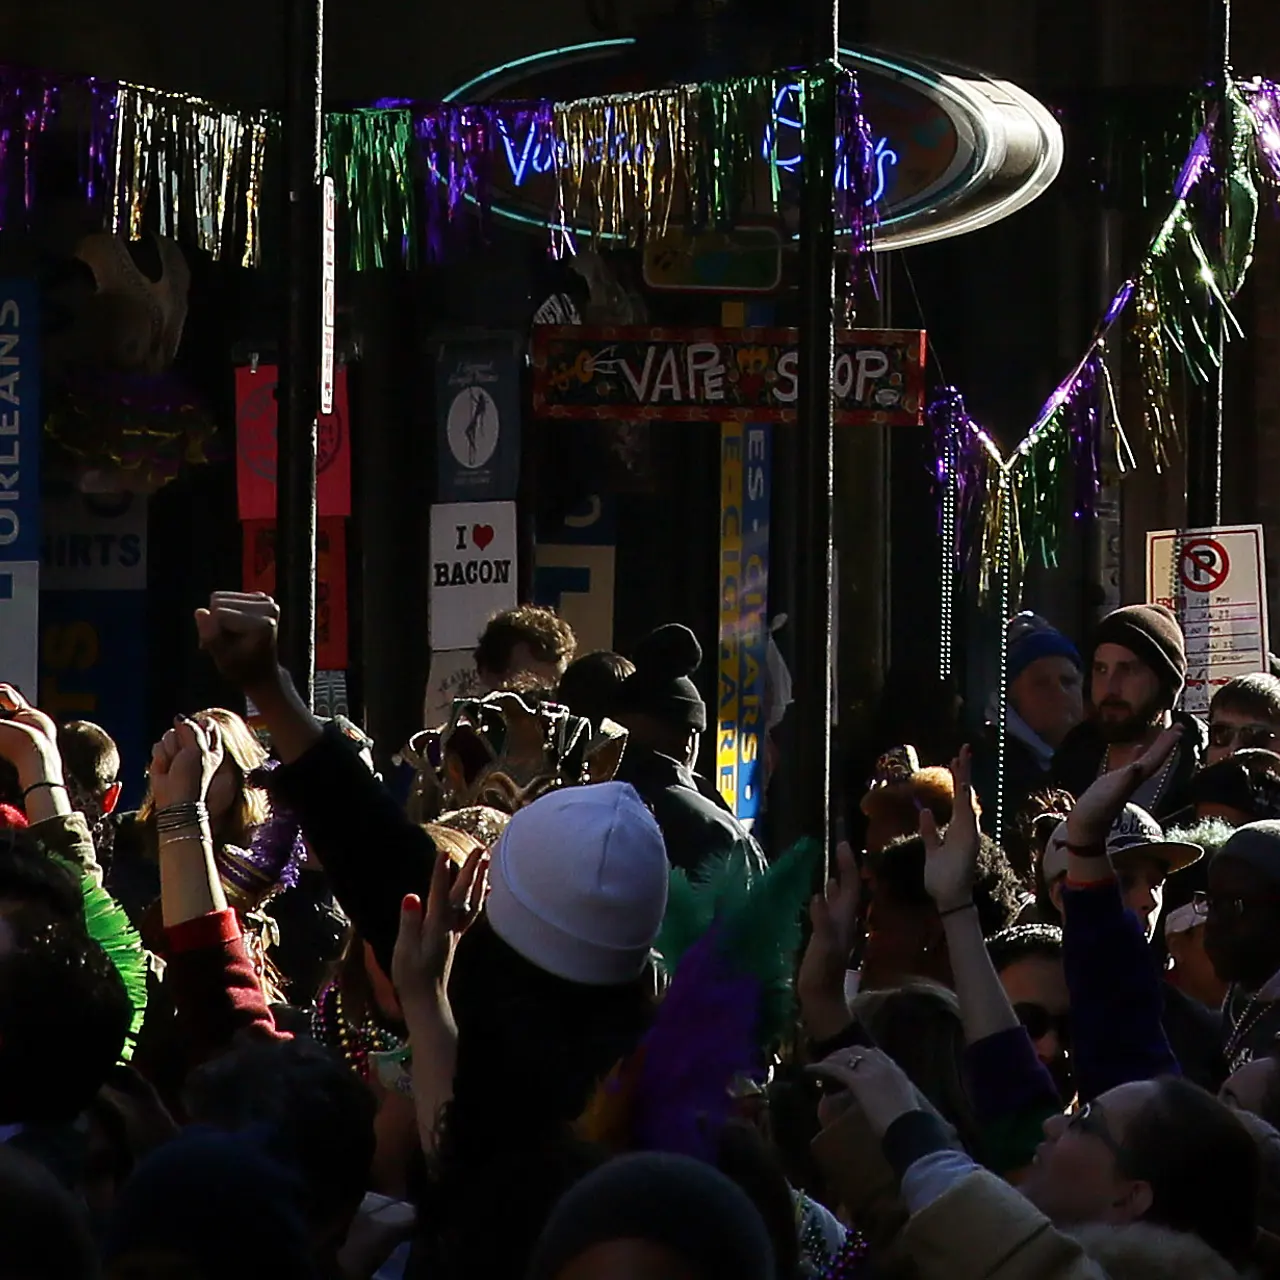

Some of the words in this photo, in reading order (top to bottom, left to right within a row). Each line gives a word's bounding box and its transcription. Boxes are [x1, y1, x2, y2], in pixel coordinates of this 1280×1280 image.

[618, 343, 725, 404] VAPE
[773, 349, 891, 404] SOP
[455, 525, 467, 550] I
[434, 559, 511, 587] BACON
